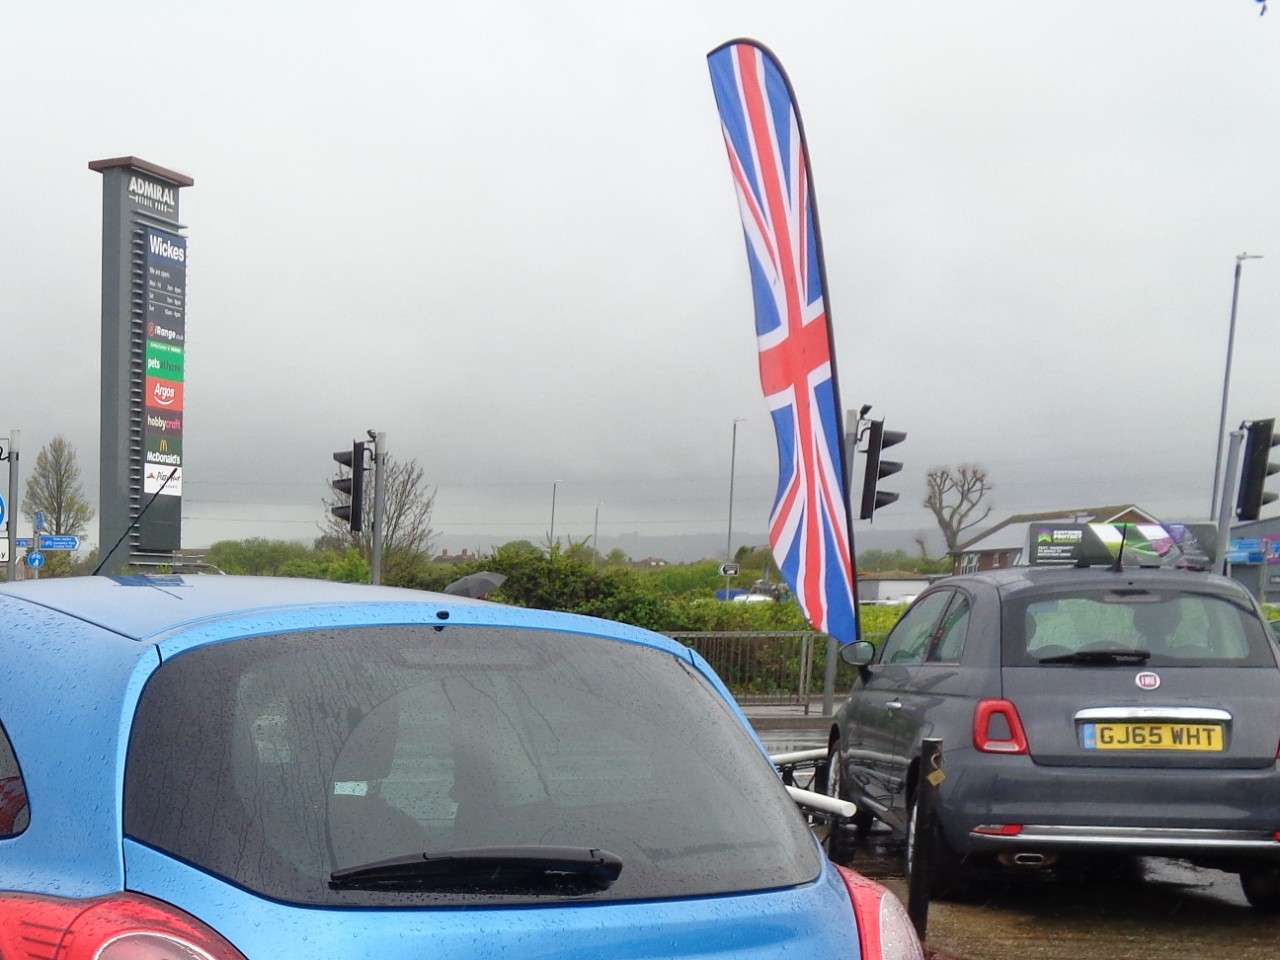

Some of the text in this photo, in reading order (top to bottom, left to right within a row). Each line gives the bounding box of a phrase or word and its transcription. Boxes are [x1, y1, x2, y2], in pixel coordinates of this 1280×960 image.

[129, 176, 175, 206] ADMIRAL
[150, 234, 185, 262] Wickes
[154, 383, 175, 400] Argos
[146, 450, 181, 465] McDonald's
[1100, 726, 1216, 746] GJ65 WHT
